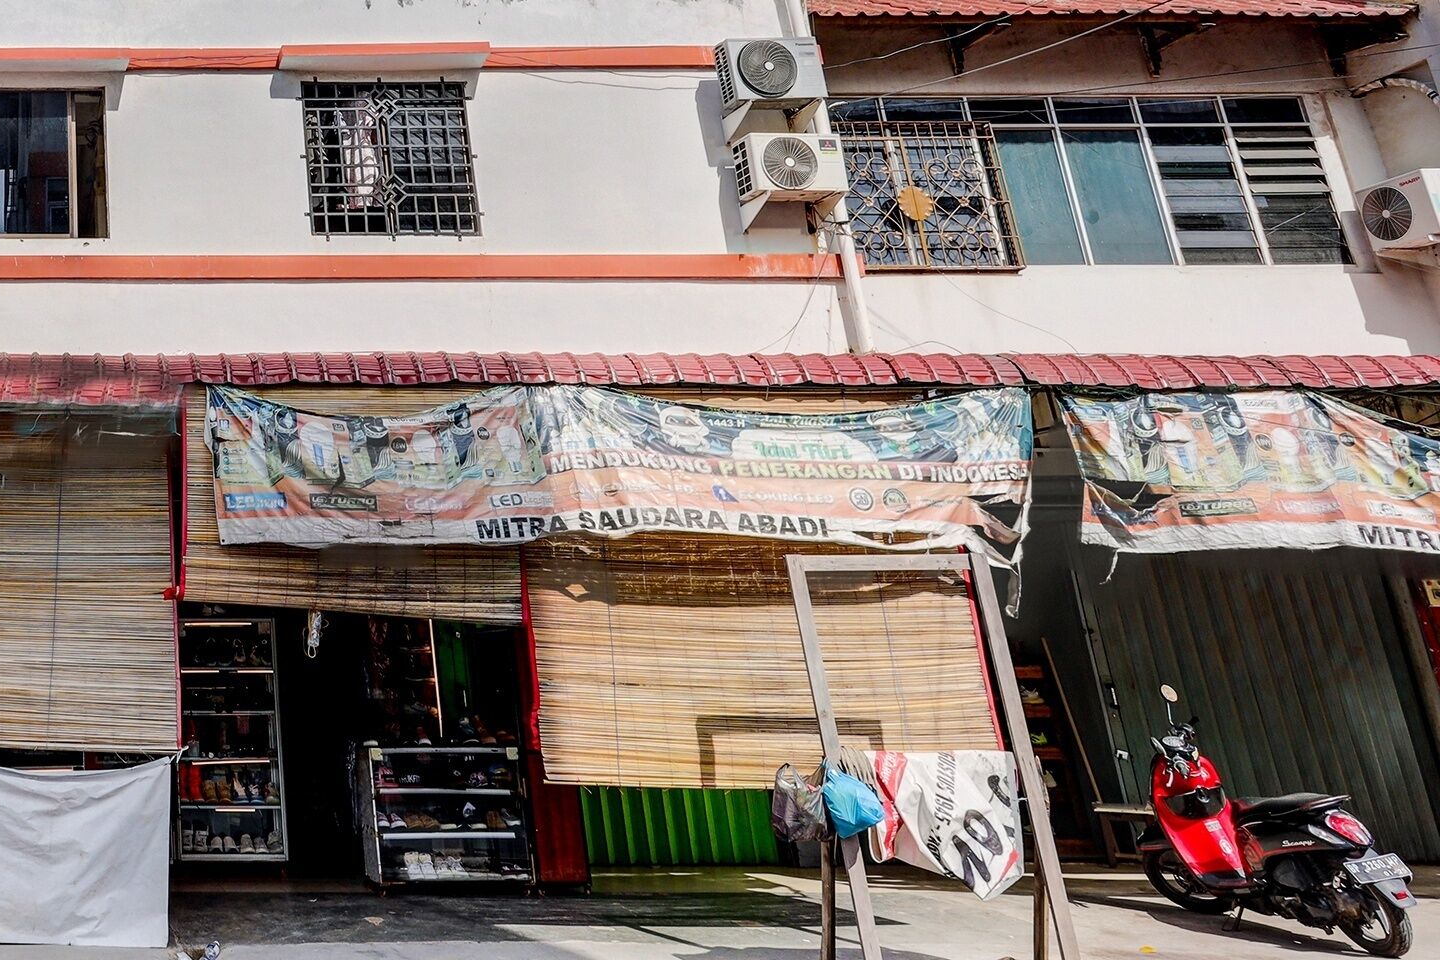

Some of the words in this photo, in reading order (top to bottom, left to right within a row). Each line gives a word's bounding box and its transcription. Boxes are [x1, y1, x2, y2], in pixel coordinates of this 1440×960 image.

[707, 418, 734, 427] 1443
[549, 451, 713, 474] MENDUKUNG
[718, 459, 892, 481] PENERANGAN
[896, 464, 924, 481] DI
[490, 493, 523, 508] LED
[475, 514, 569, 540] MITRA
[578, 507, 729, 532] SAUDARA
[738, 512, 830, 538] ABADI
[1357, 524, 1440, 552] MITR
[934, 793, 956, 827] 1945
[1282, 839, 1315, 848] Scoopy
